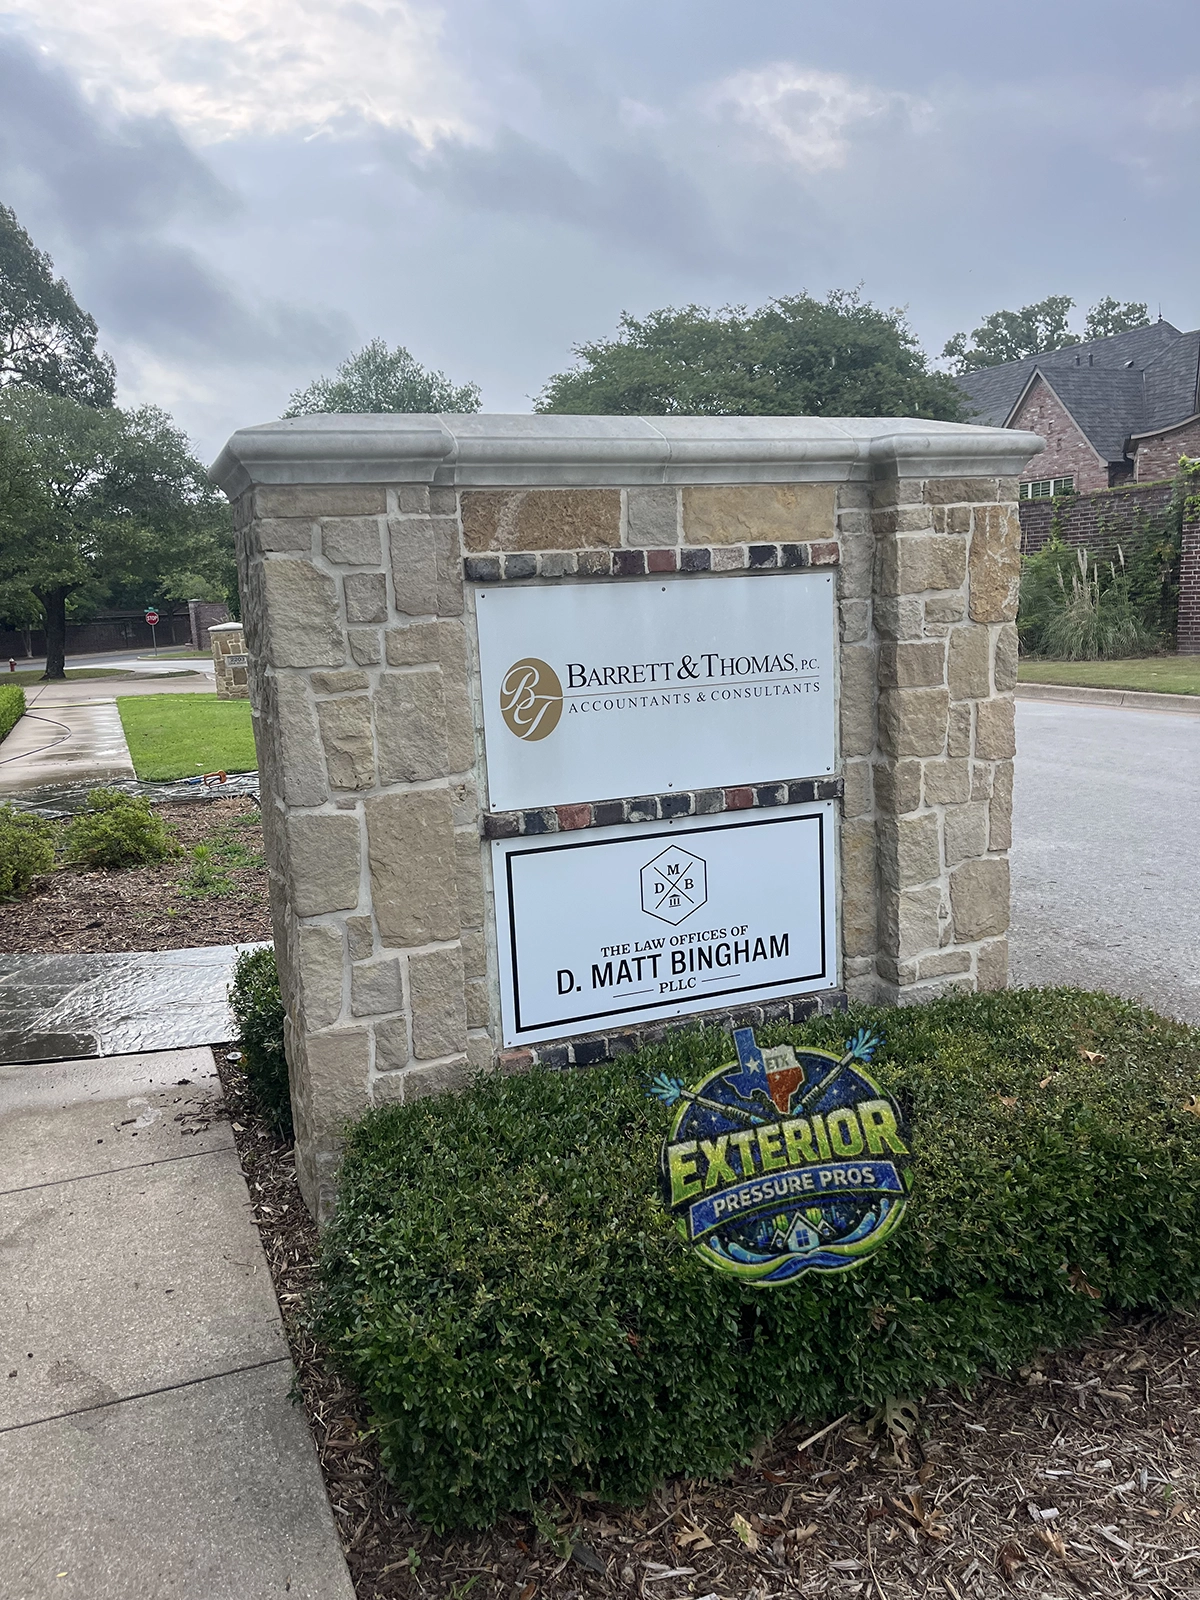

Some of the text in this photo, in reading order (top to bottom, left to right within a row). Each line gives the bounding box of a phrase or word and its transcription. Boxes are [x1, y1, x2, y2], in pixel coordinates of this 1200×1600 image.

[568, 681, 821, 714] ACCOUNTANTS & CONSULTANTS
[666, 864, 680, 876] M
[654, 878, 694, 894] D B
[600, 925, 749, 958] THE LAW OFFICES OF
[556, 933, 790, 995] D. MATT BINGHAM
[659, 977, 697, 994] PLLC
